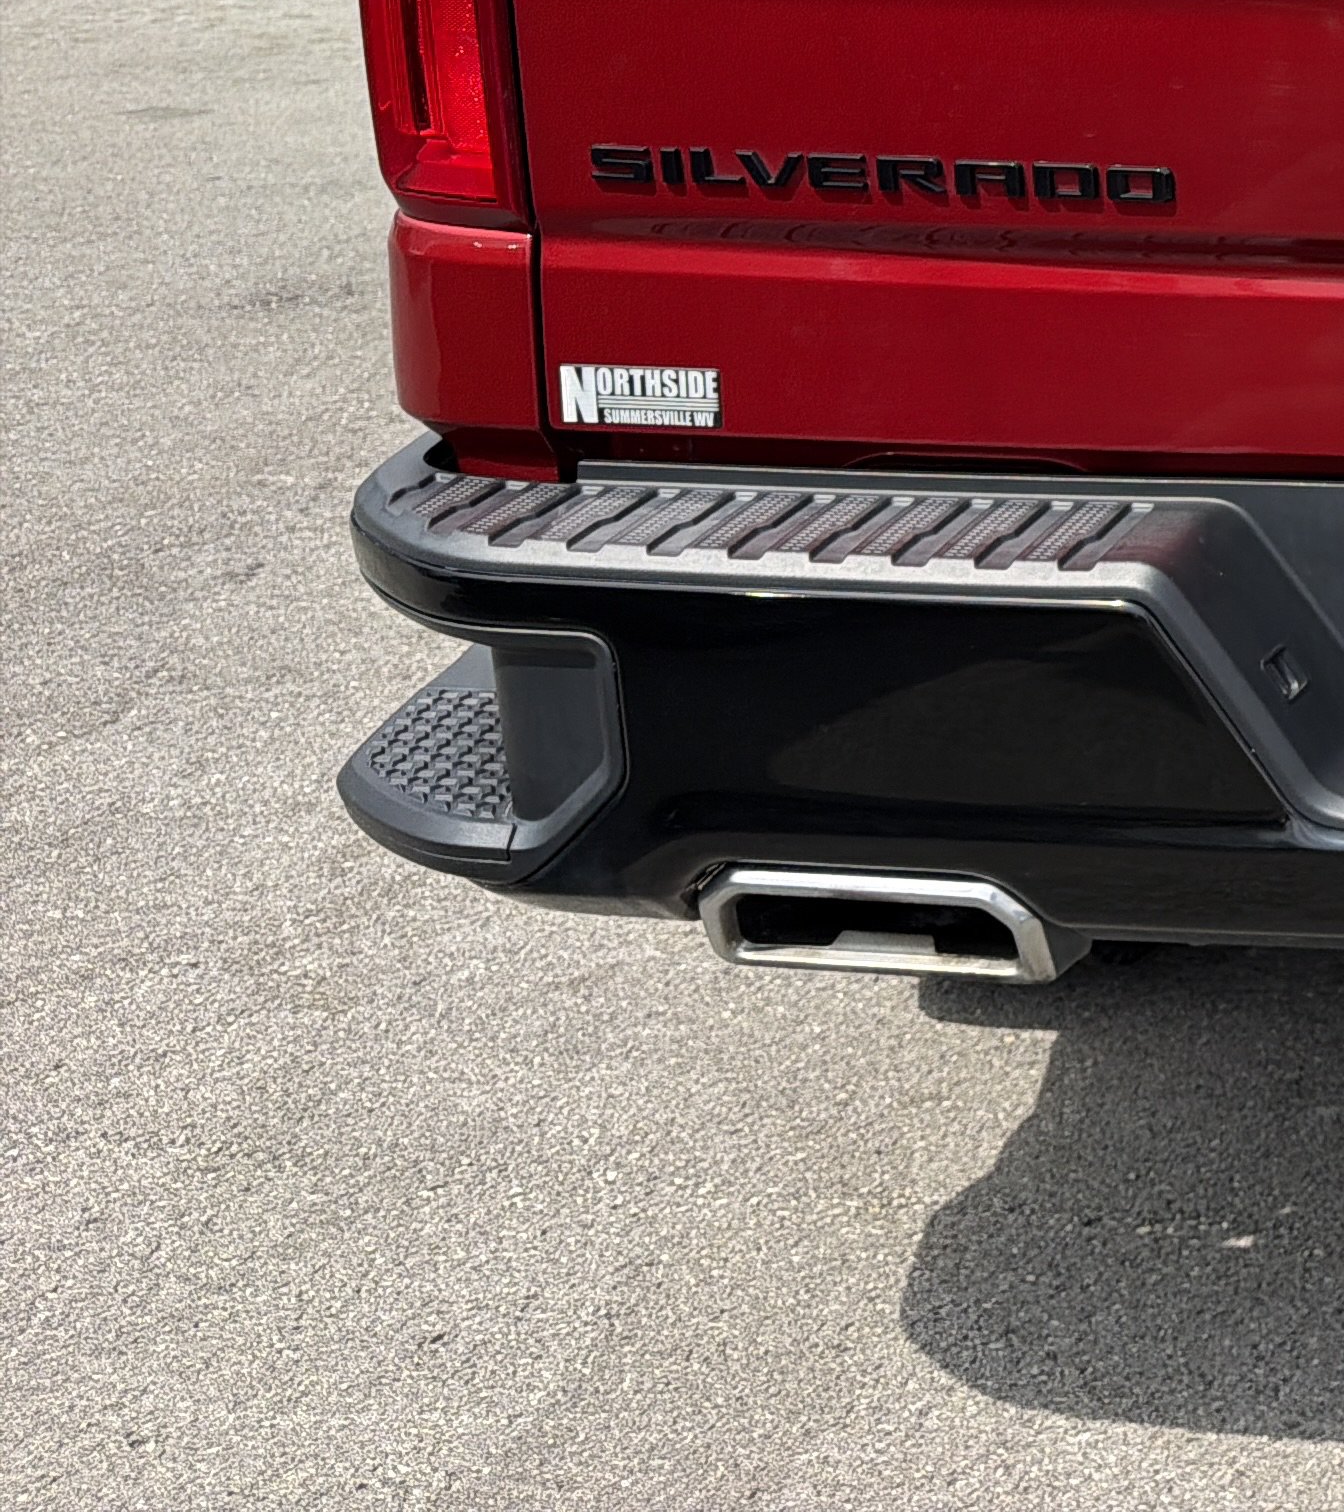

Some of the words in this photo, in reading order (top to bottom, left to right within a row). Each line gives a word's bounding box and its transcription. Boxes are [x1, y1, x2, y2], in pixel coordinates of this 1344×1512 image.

[591, 143, 1177, 203] SILVERADO
[559, 365, 719, 424] NORTHSIDE
[603, 408, 692, 427] SUMMERSVILLE
[693, 412, 715, 427] WV
